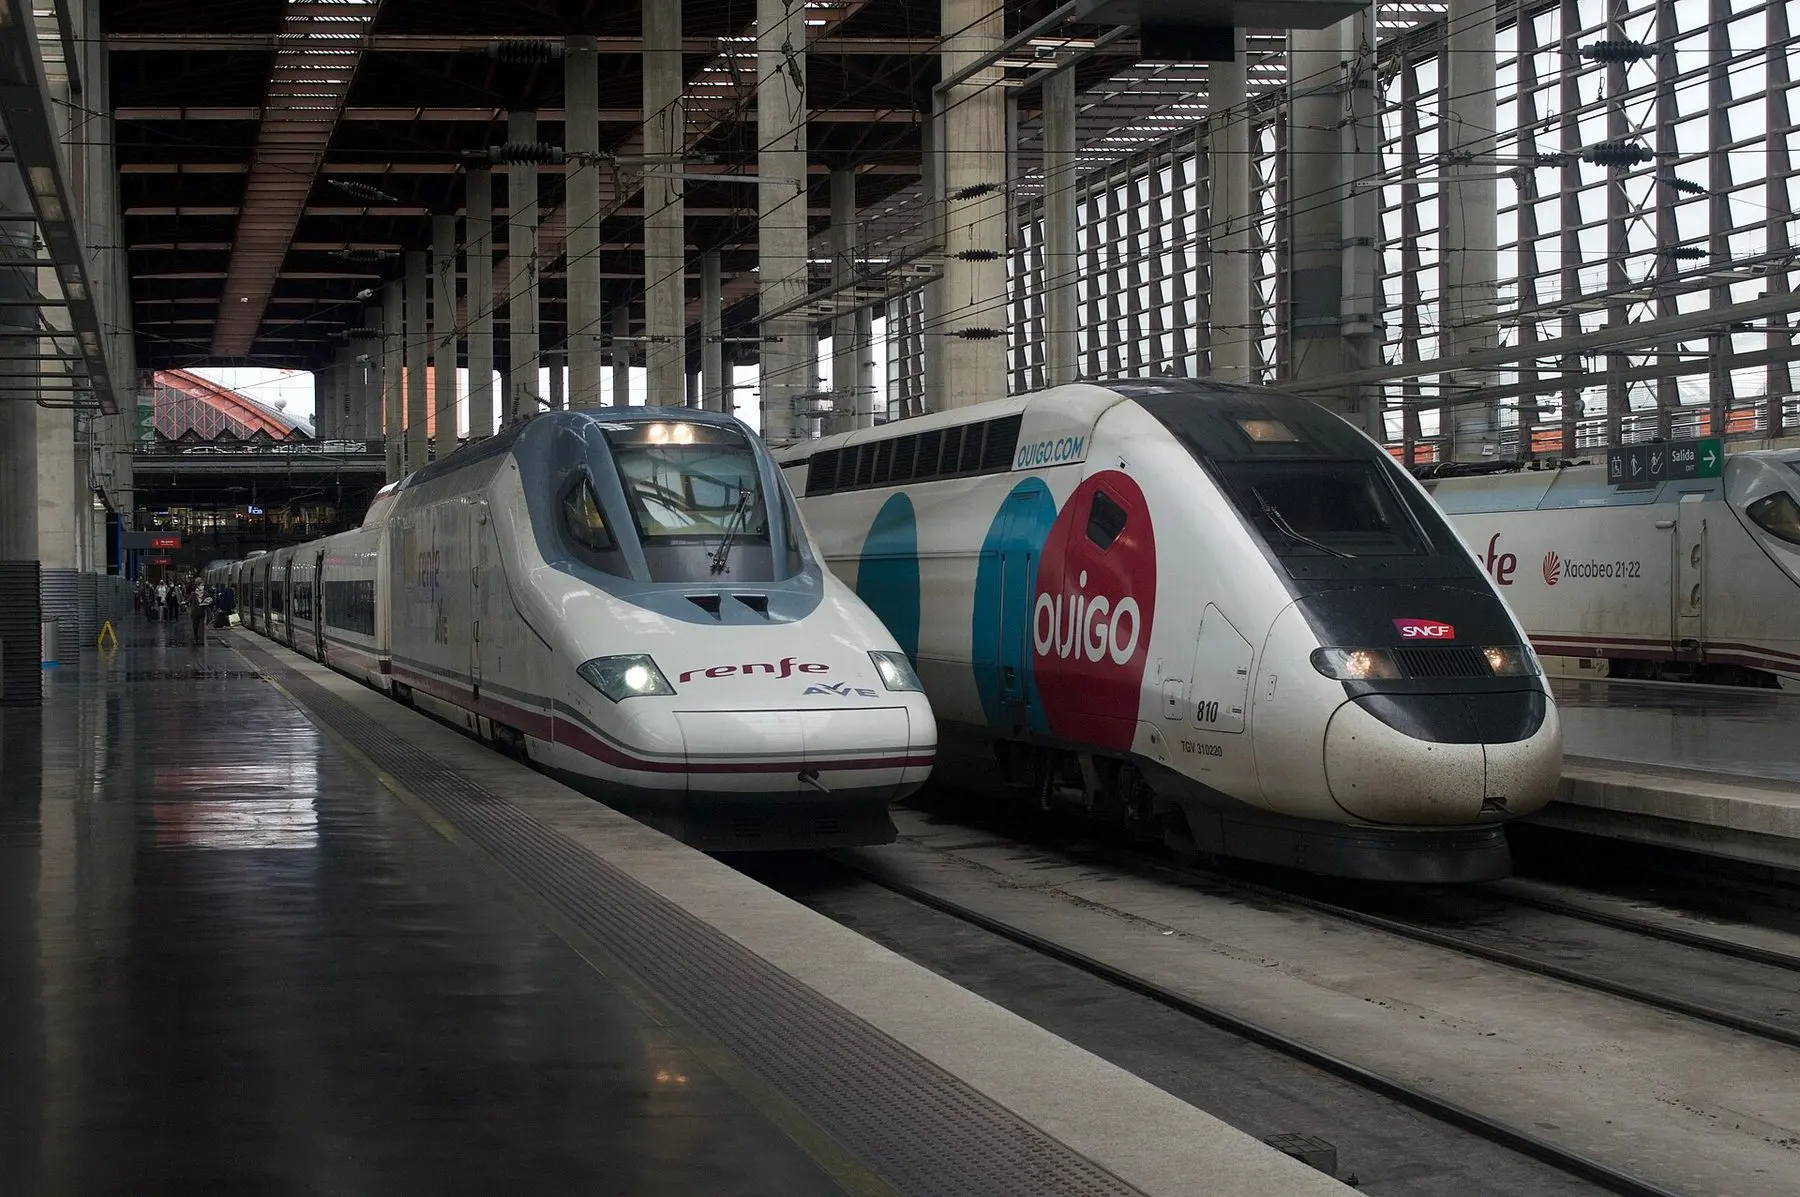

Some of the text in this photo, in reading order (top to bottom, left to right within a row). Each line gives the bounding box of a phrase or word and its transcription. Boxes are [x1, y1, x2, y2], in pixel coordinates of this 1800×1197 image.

[1017, 436, 1085, 467] OUIGO.COM
[1671, 449, 1695, 462] Salida
[418, 526, 440, 609] renfe
[1563, 559, 1614, 578] Xacobeo
[1402, 625, 1449, 637] SNCF
[679, 656, 830, 683] renfe
[803, 682, 880, 698] AVE
[1197, 700, 1219, 723] 810
[1181, 740, 1223, 757] TGV 310220
